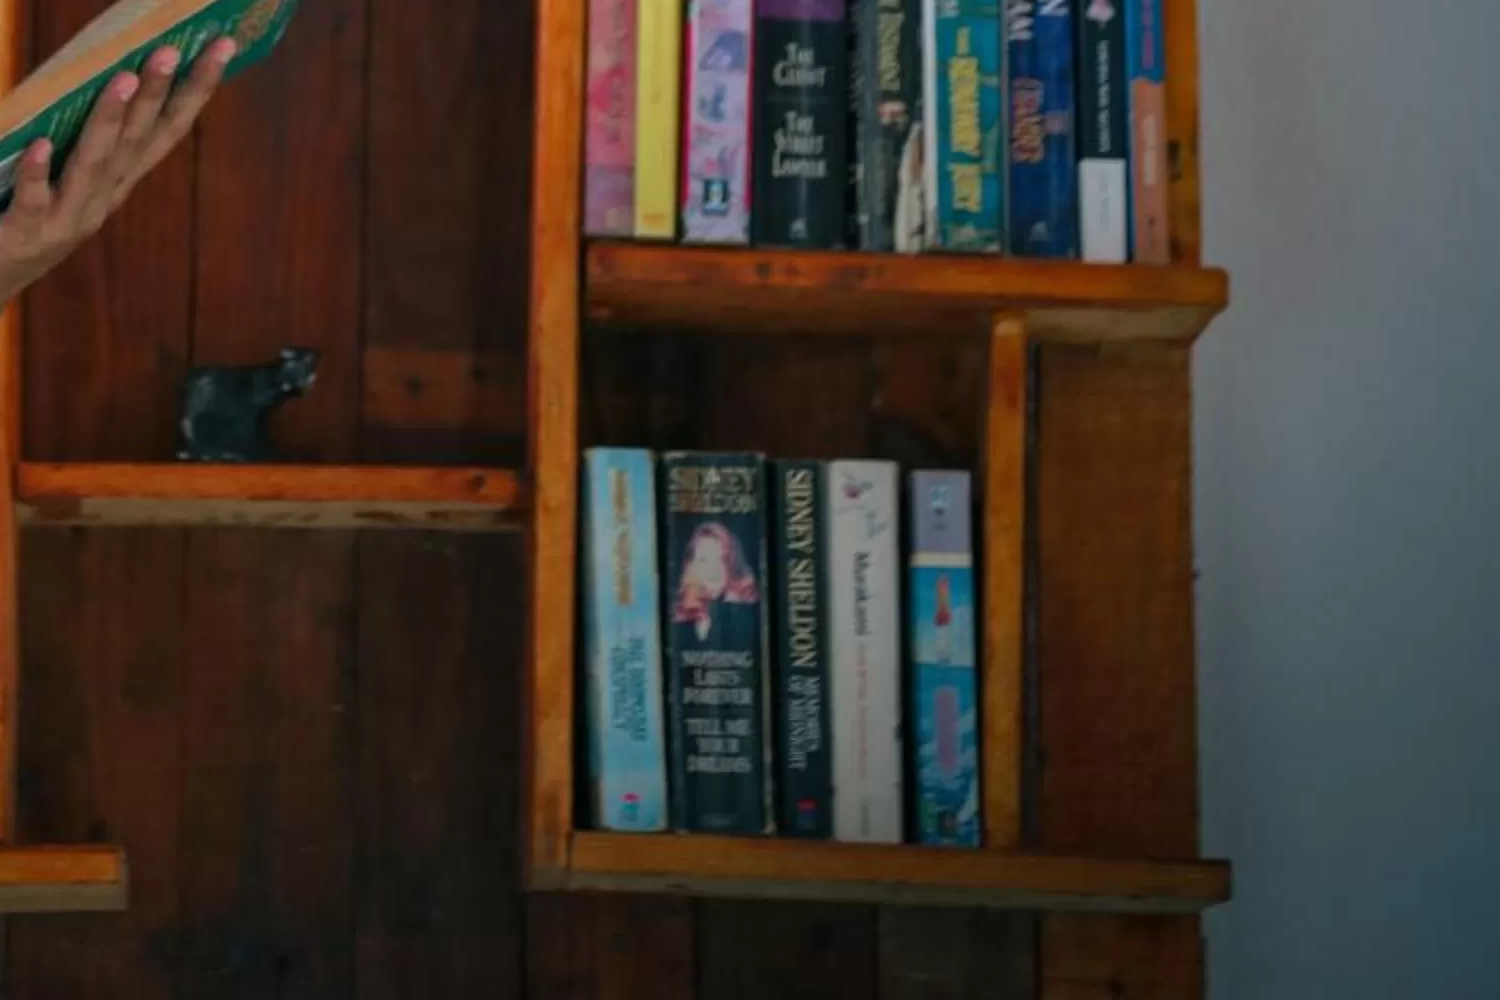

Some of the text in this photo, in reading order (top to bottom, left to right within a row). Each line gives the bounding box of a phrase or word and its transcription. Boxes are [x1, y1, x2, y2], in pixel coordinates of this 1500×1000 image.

[786, 469, 818, 669] SIDNEY SHELDON
[853, 551, 872, 637] Murakami
